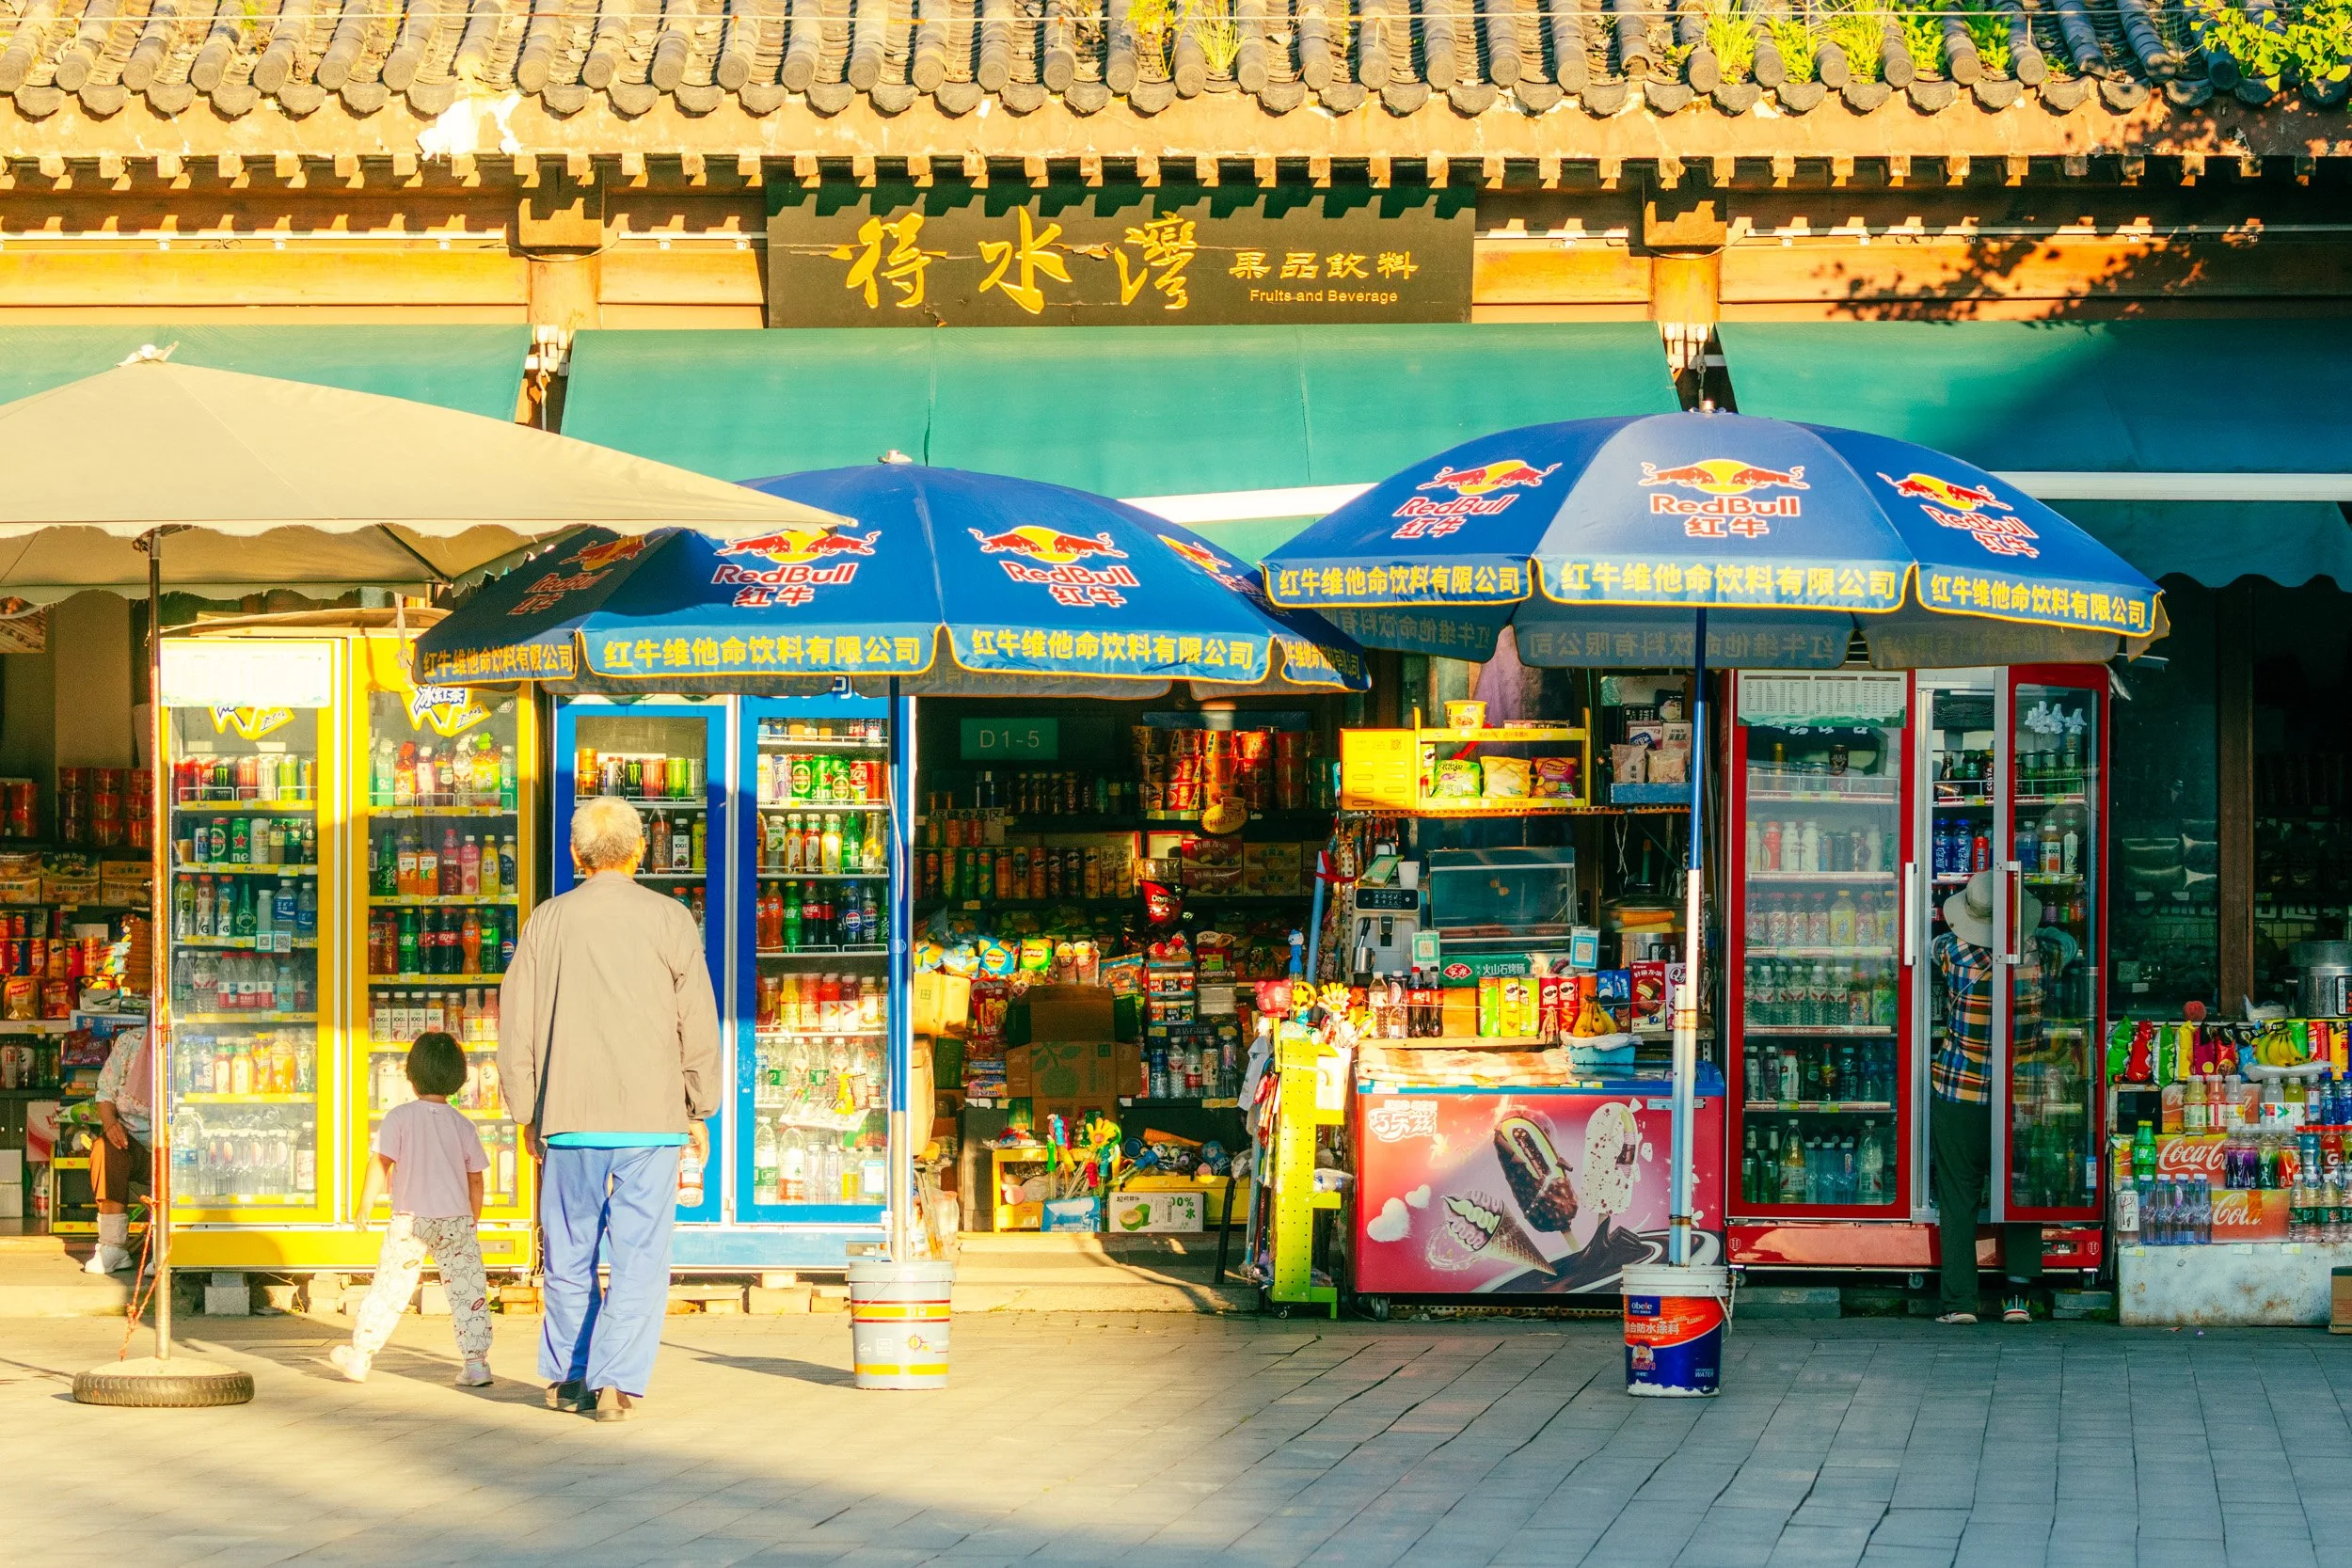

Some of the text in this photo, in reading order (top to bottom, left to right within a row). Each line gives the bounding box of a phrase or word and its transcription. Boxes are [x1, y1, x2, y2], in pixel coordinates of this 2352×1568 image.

[1229, 250, 1419, 279] 果品飲料
[1249, 289, 1398, 304] Fruits and Beverage
[1392, 494, 1520, 516] RedBull
[1649, 493, 1801, 517] RedBull
[1391, 516, 1467, 539] 红牛
[1683, 516, 1770, 539] 红牛
[1920, 504, 2040, 539] RedBull
[1972, 530, 2041, 559] 红牛
[711, 562, 859, 585] RedBull
[998, 560, 1141, 587] RedBull
[1279, 565, 1520, 594] 红牛维他命饮料有限公司
[1561, 562, 1896, 600] 红牛维他命饮料有限公司
[733, 585, 816, 607] 红牛
[1047, 584, 1128, 609] 红牛
[1931, 574, 2146, 630] 红牛维他命饮料有限公司
[423, 643, 574, 676] 红牛维他命饮料有限公司
[604, 637, 921, 669] 红牛维他命饮料有限公司
[972, 629, 1254, 671] 红牛维他命饮料有限公司
[979, 730, 1040, 749] D1-5
[1152, 895, 1176, 905] Doritos
[1482, 962, 1526, 975] 火山石烤肠
[1370, 1109, 1437, 1140] 巧乐兹
[2327, 1153, 2339, 1165] G
[1185, 1209, 1196, 1220] 水
